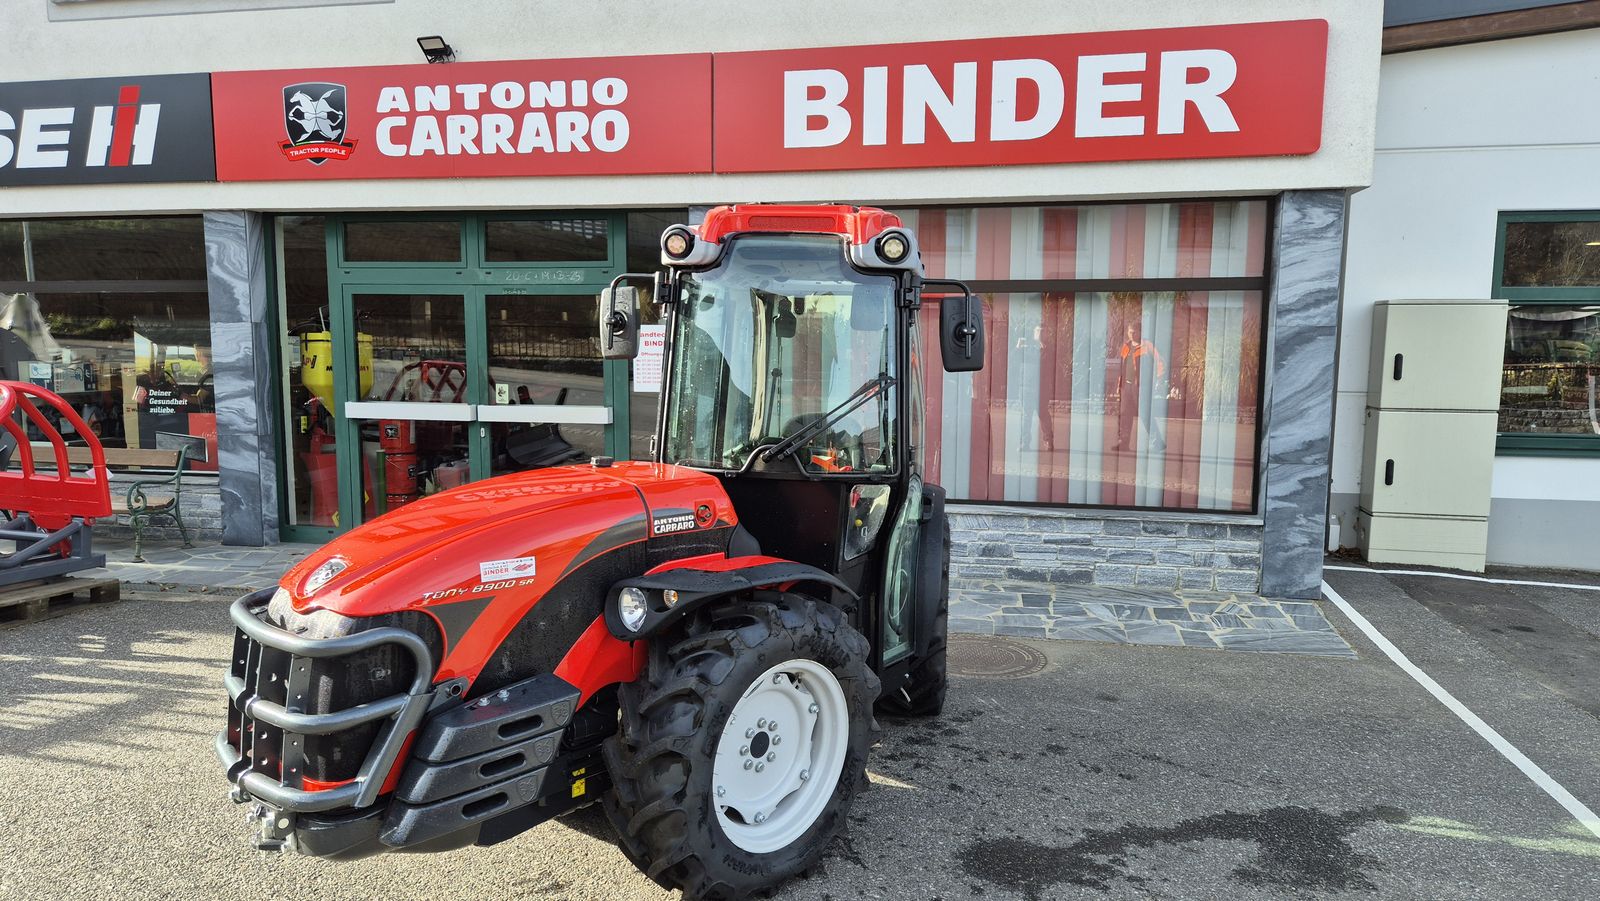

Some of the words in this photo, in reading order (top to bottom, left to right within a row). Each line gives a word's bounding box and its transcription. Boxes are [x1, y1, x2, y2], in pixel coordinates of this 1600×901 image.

[376, 77, 628, 113] ANTONIO
[783, 48, 1240, 149] BINDER
[376, 109, 630, 157] CARRARO
[290, 147, 319, 157] TRACTOR
[320, 147, 346, 156] PEOPLE
[149, 389, 172, 397] Deiner
[149, 398, 188, 406] Gesundheit
[149, 406, 176, 414] zuliebe.
[654, 514, 694, 526] ANTONIO
[654, 520, 694, 534] CARRARO
[472, 580, 516, 593] 8900
[518, 578, 534, 586] SR
